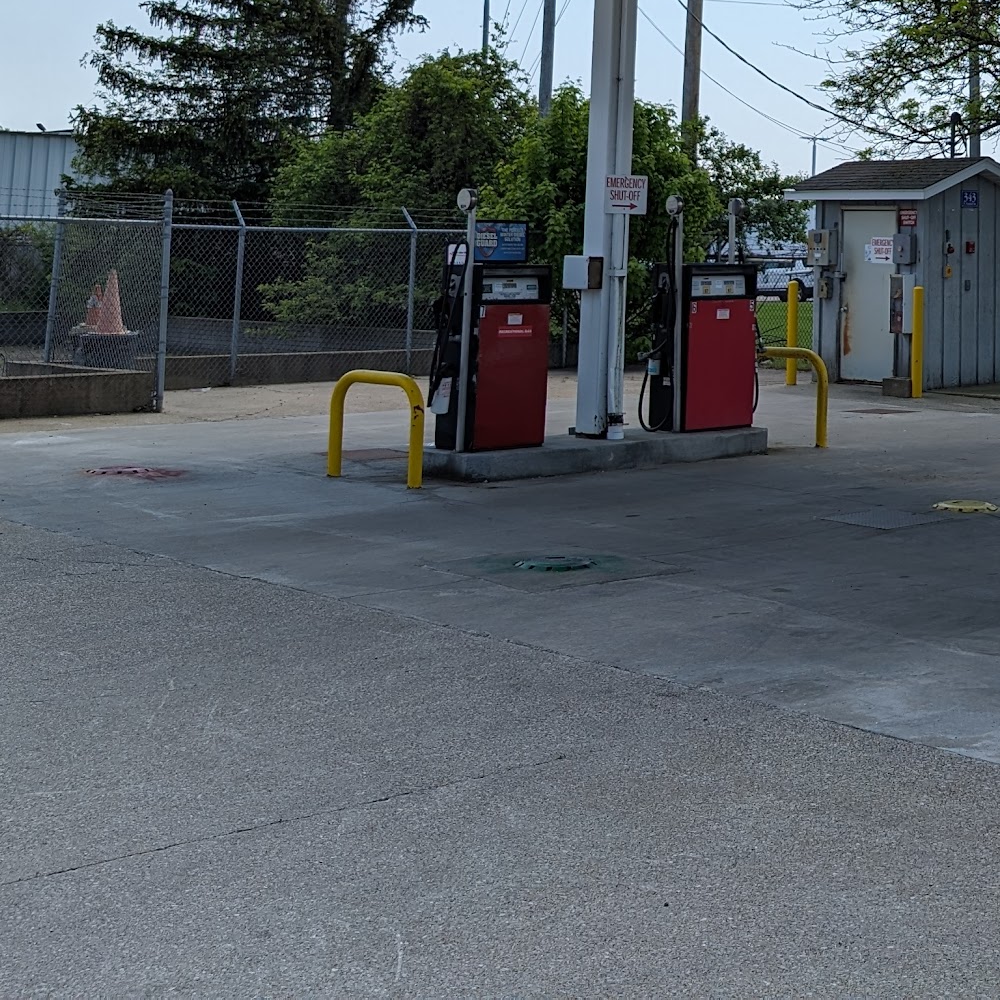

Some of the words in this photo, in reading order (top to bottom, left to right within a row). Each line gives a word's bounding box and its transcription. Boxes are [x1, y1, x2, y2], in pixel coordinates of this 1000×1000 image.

[606, 177, 646, 189] EMERGENCY
[610, 190, 641, 201] SHUT-OFF
[476, 232, 498, 240] DIESEL
